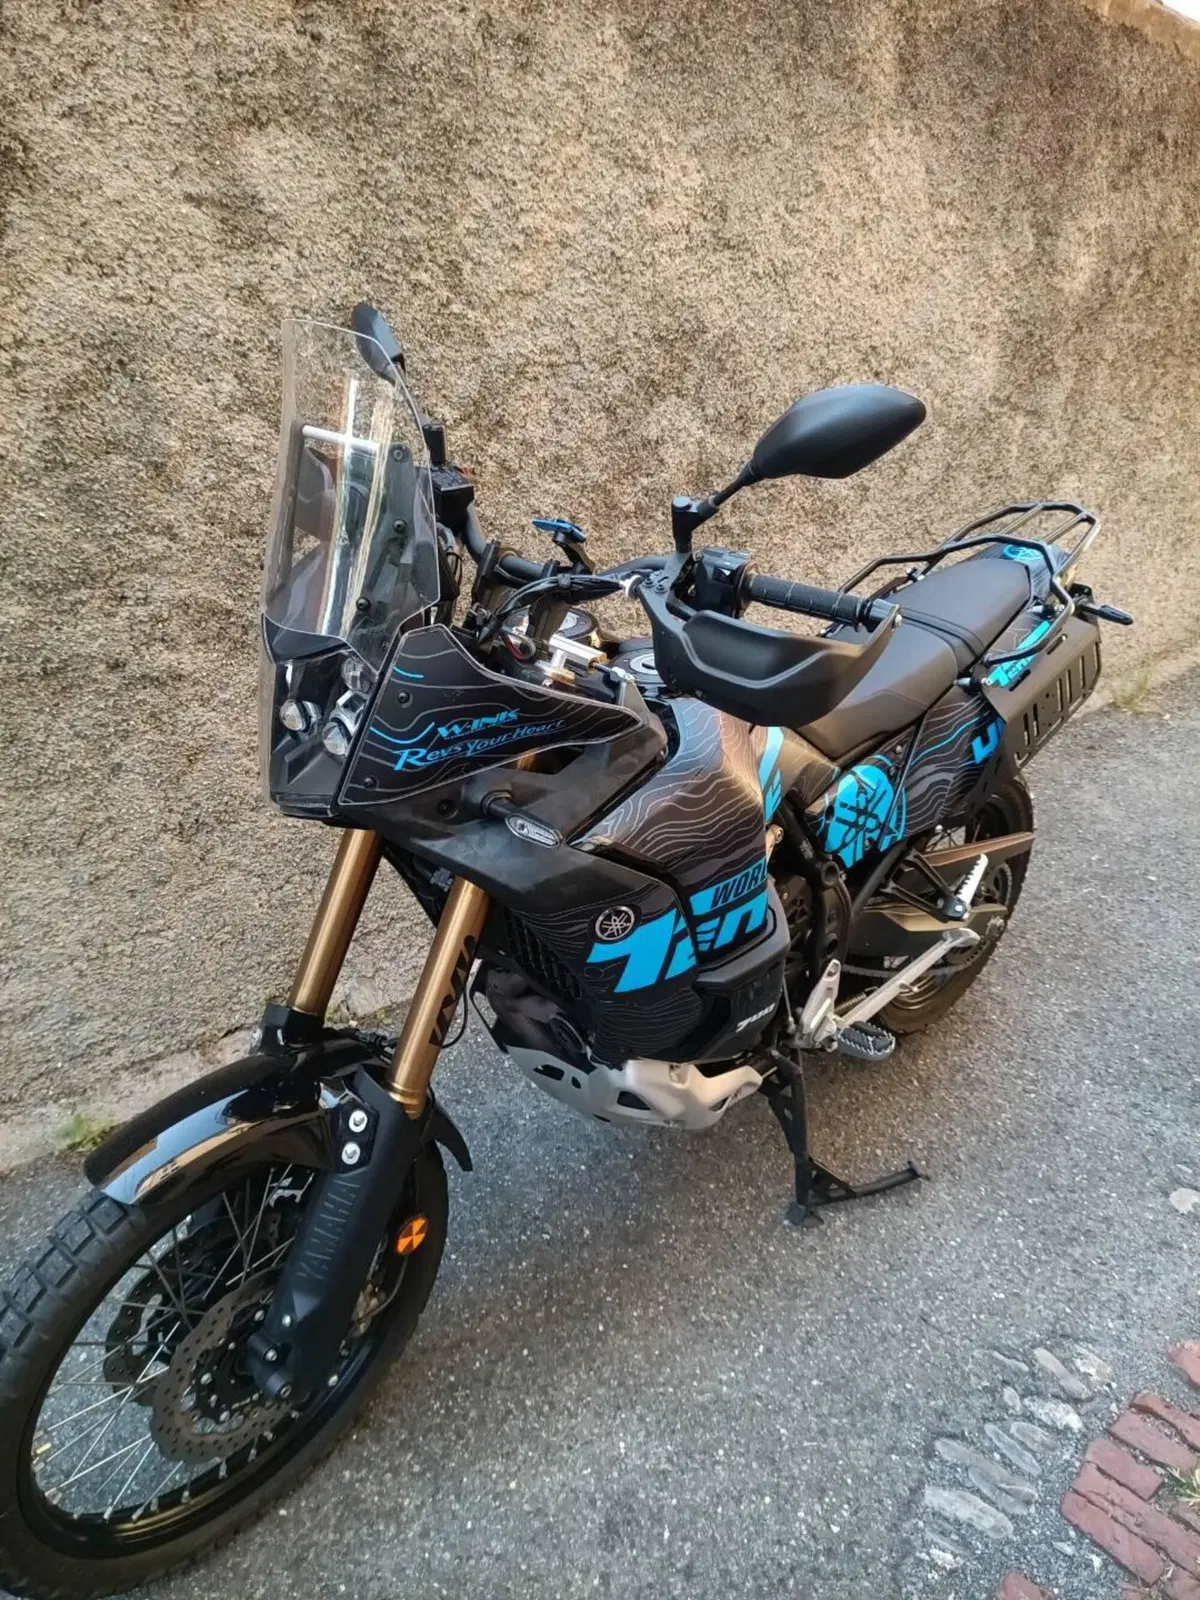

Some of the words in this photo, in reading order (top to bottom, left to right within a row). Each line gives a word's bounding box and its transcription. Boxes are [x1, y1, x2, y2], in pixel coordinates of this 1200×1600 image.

[393, 745, 462, 770] Revs
[464, 731, 512, 757] Your
[511, 718, 565, 738] Heart
[710, 857, 767, 909] WORL
[297, 1178, 361, 1281] YAMAHA
